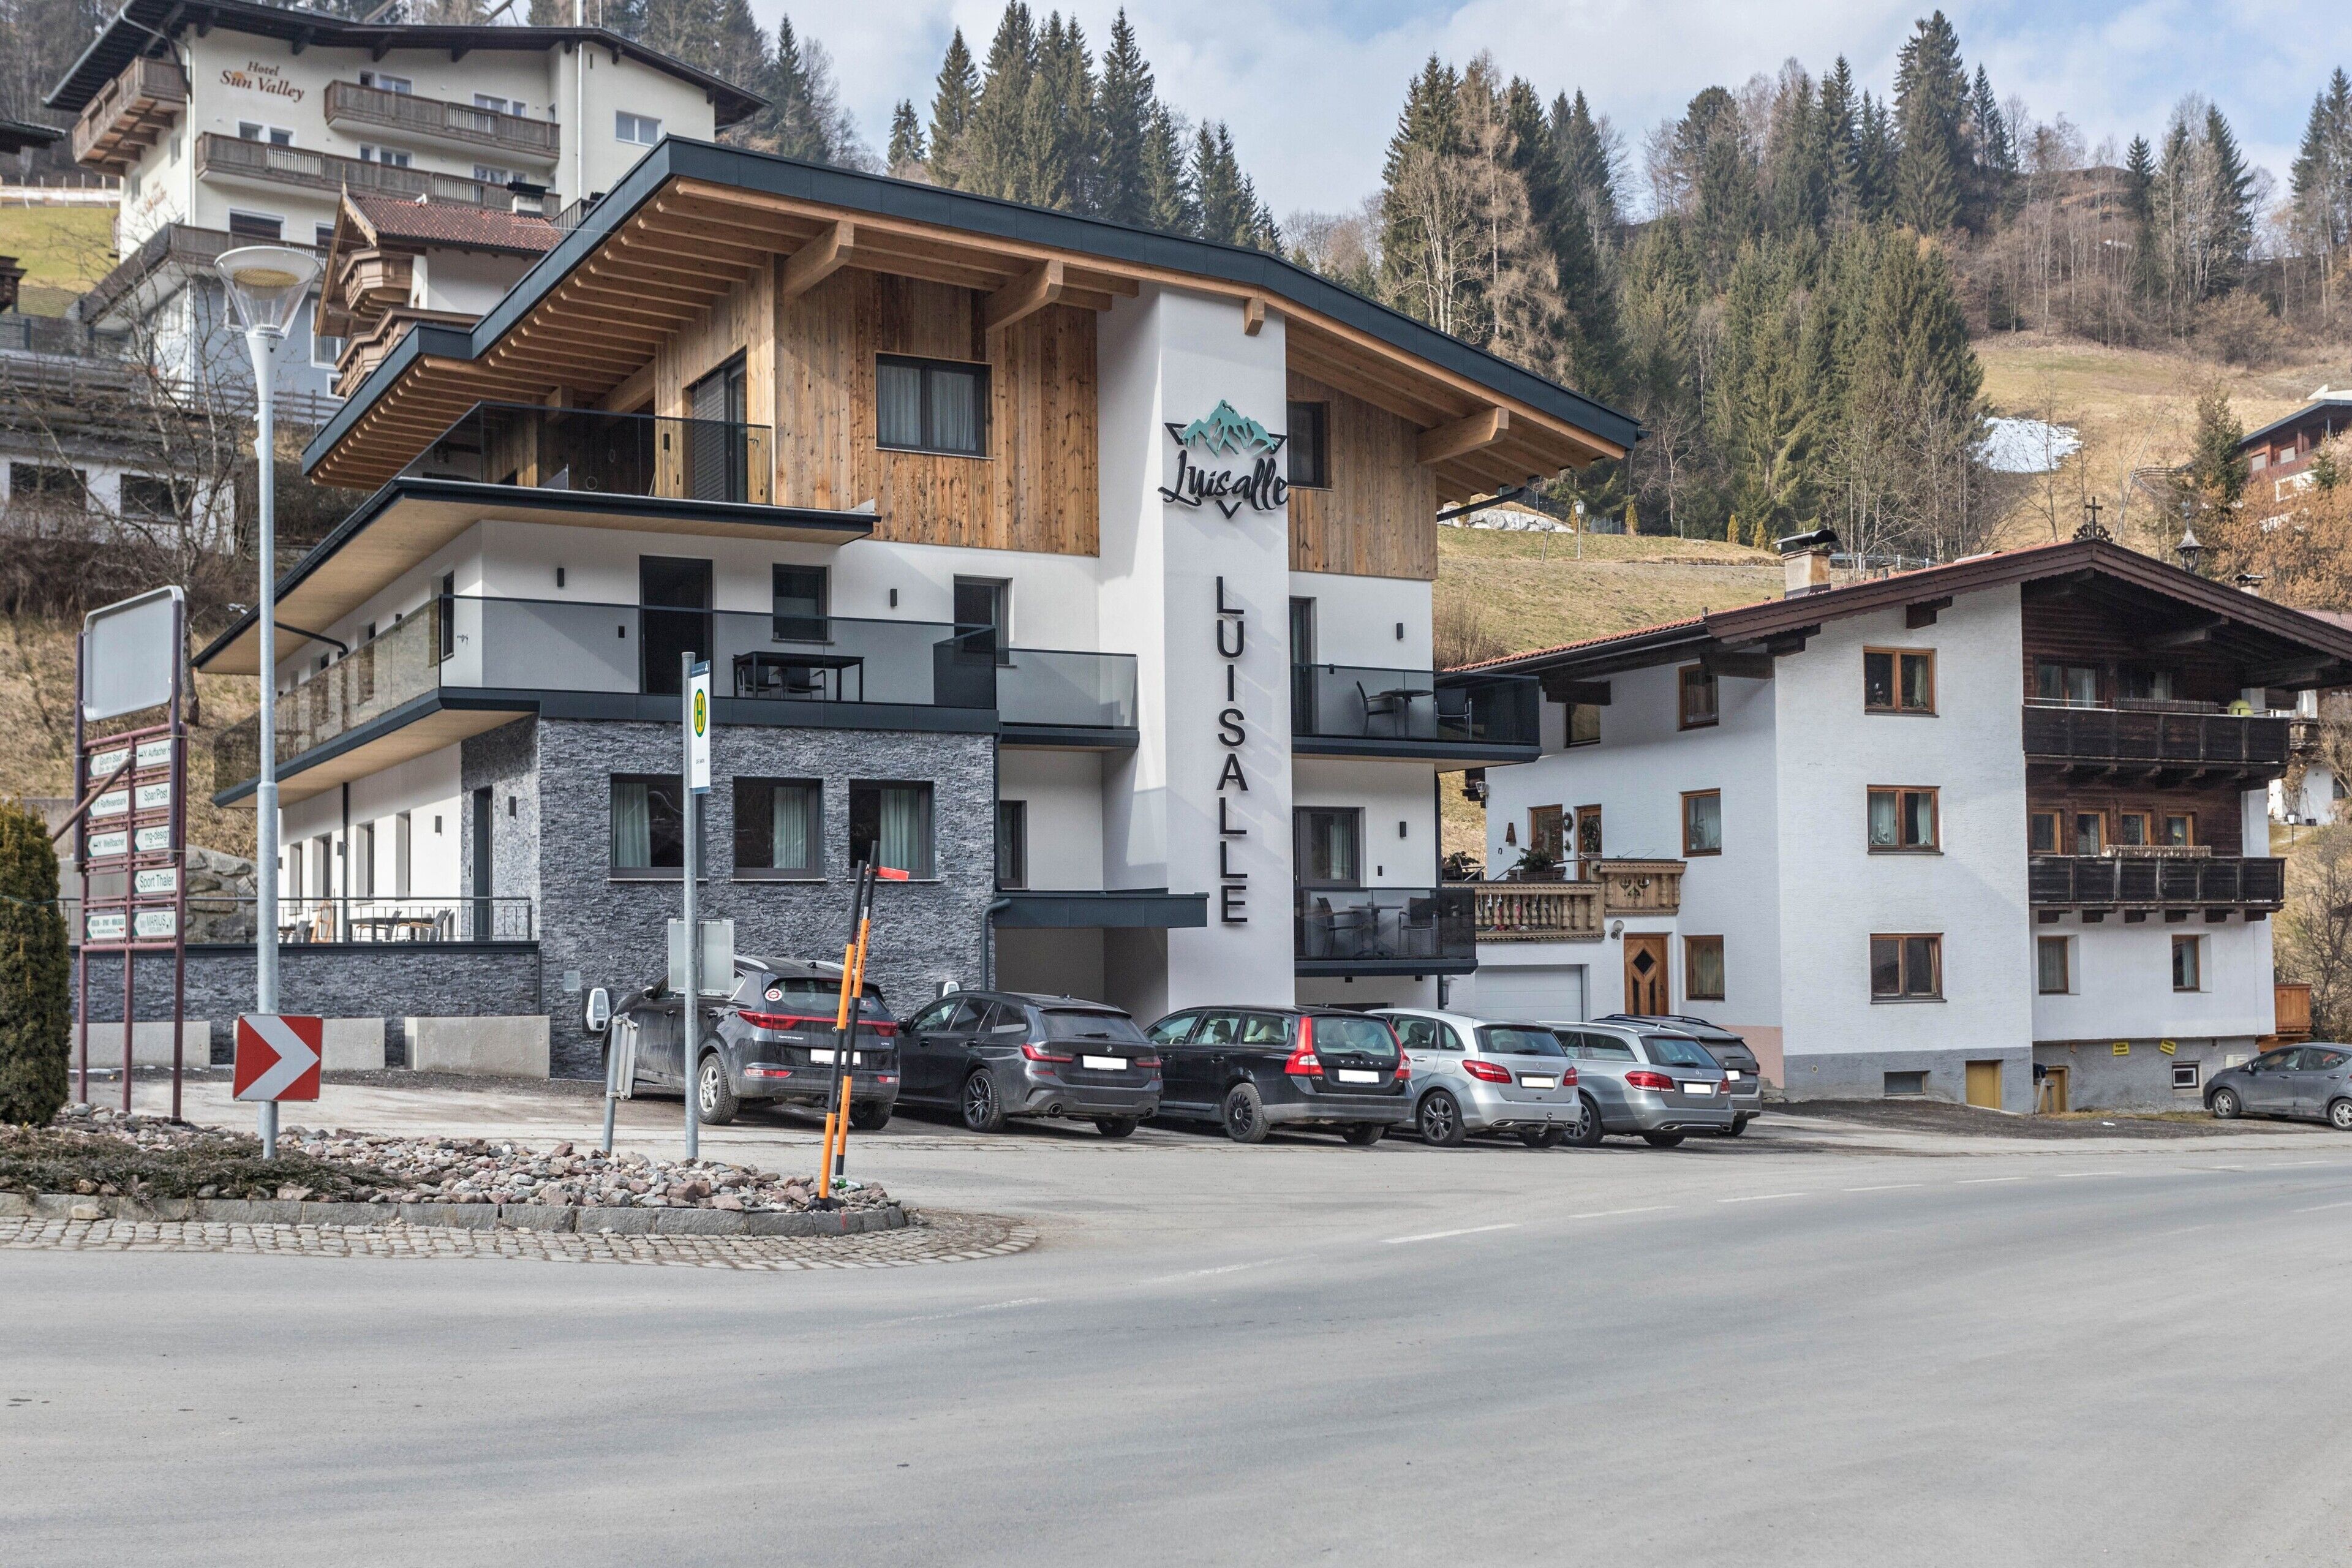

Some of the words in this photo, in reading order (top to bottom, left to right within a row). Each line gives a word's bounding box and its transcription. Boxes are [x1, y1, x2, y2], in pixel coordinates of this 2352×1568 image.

[247, 61, 280, 76] Hotel
[219, 70, 252, 89] Sun
[258, 77, 304, 103] Valley
[1158, 449, 1289, 511] Luisalle
[1216, 576, 1248, 922] LUISALLE
[144, 788, 168, 802] Spar/Post
[140, 875, 154, 891] Sport
[156, 873, 173, 886] Thaler
[147, 914, 165, 926] MARIUS
